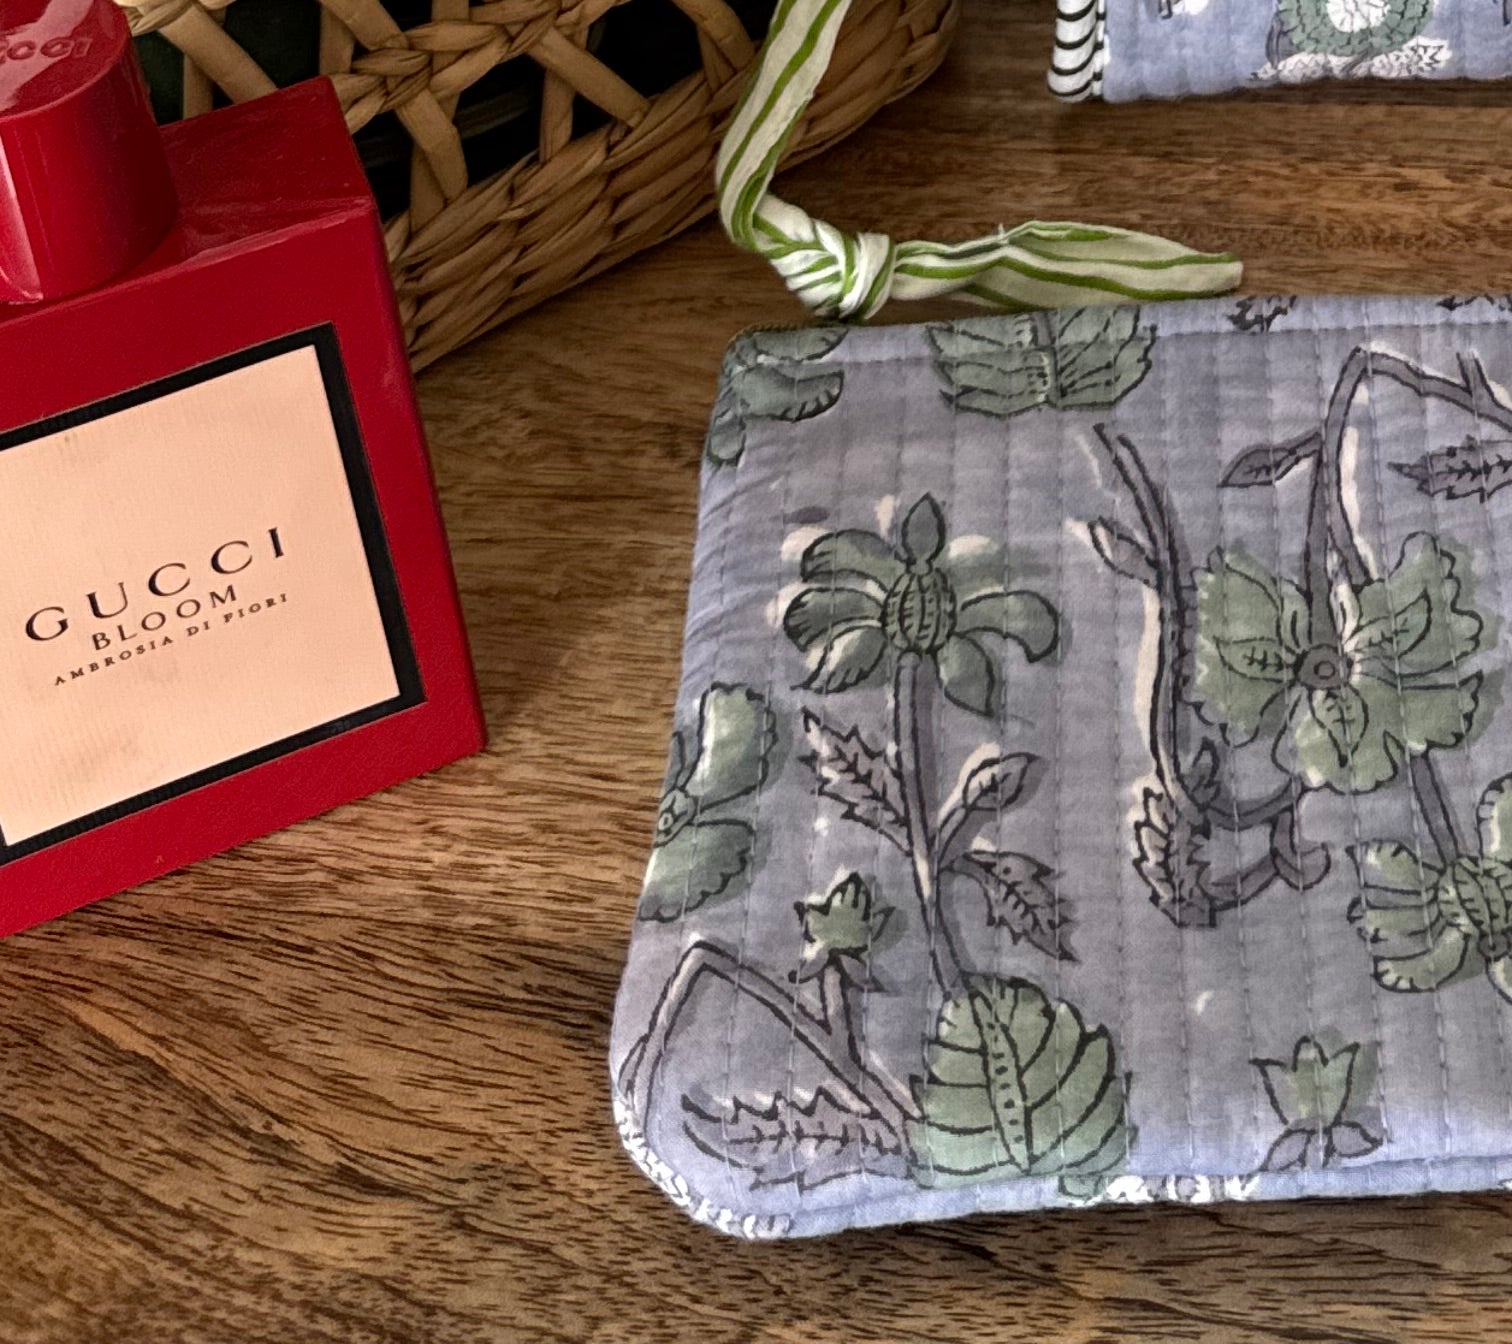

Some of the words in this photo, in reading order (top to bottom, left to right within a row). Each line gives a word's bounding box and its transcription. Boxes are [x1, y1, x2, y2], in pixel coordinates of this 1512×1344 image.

[25, 527, 285, 642] GUCCI
[91, 583, 237, 650] BLOOM
[54, 636, 174, 687] AMBROSIA
[186, 621, 211, 638] DI
[223, 593, 288, 624] FIORI
